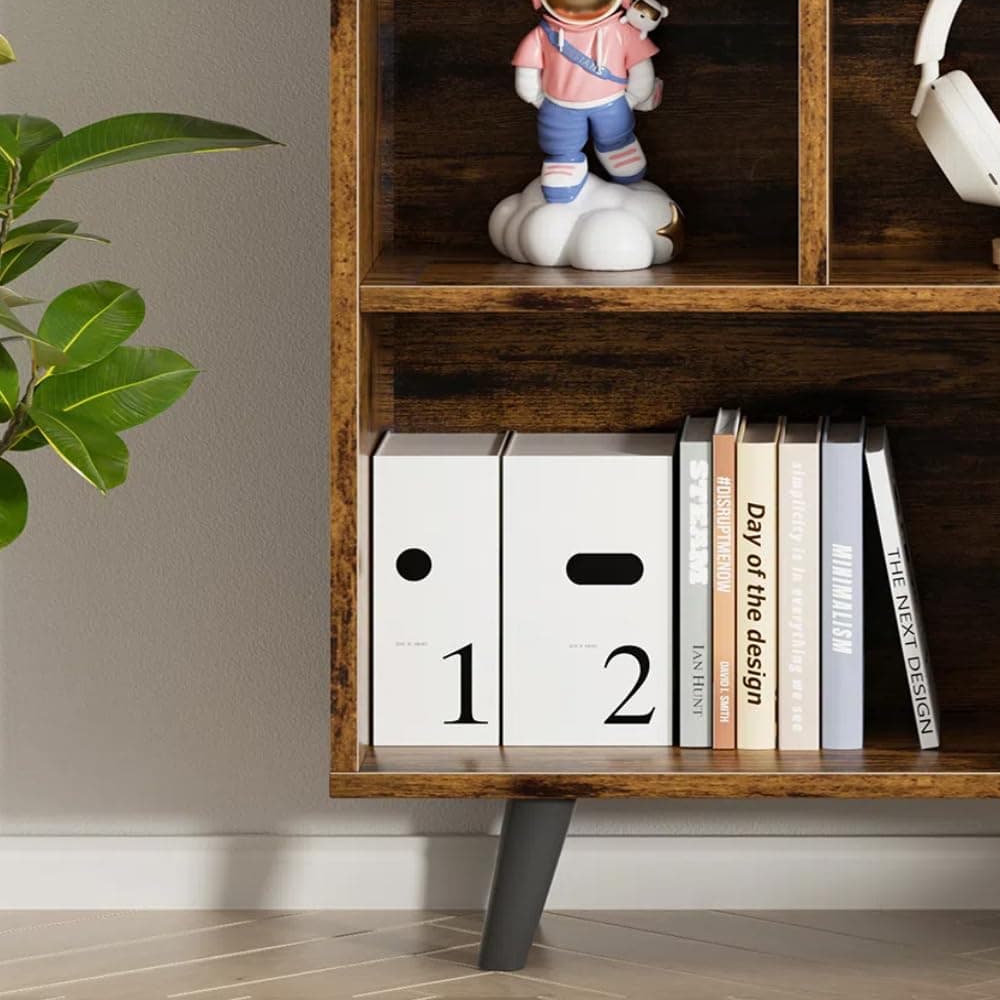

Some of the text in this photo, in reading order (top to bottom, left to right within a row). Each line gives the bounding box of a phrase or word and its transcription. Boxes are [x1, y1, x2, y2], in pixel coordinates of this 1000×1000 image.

[716, 476, 732, 593] #DISRUPTMENOW
[787, 461, 806, 542] simplicity
[743, 502, 767, 706] Day of the design
[831, 543, 853, 655] MINIMALISM
[719, 661, 729, 687] DAVID
[887, 546, 934, 735] THE NEXT DESIGN
[442, 643, 489, 725] 1
[603, 644, 656, 725] 2
[719, 695, 729, 722] SMITH
